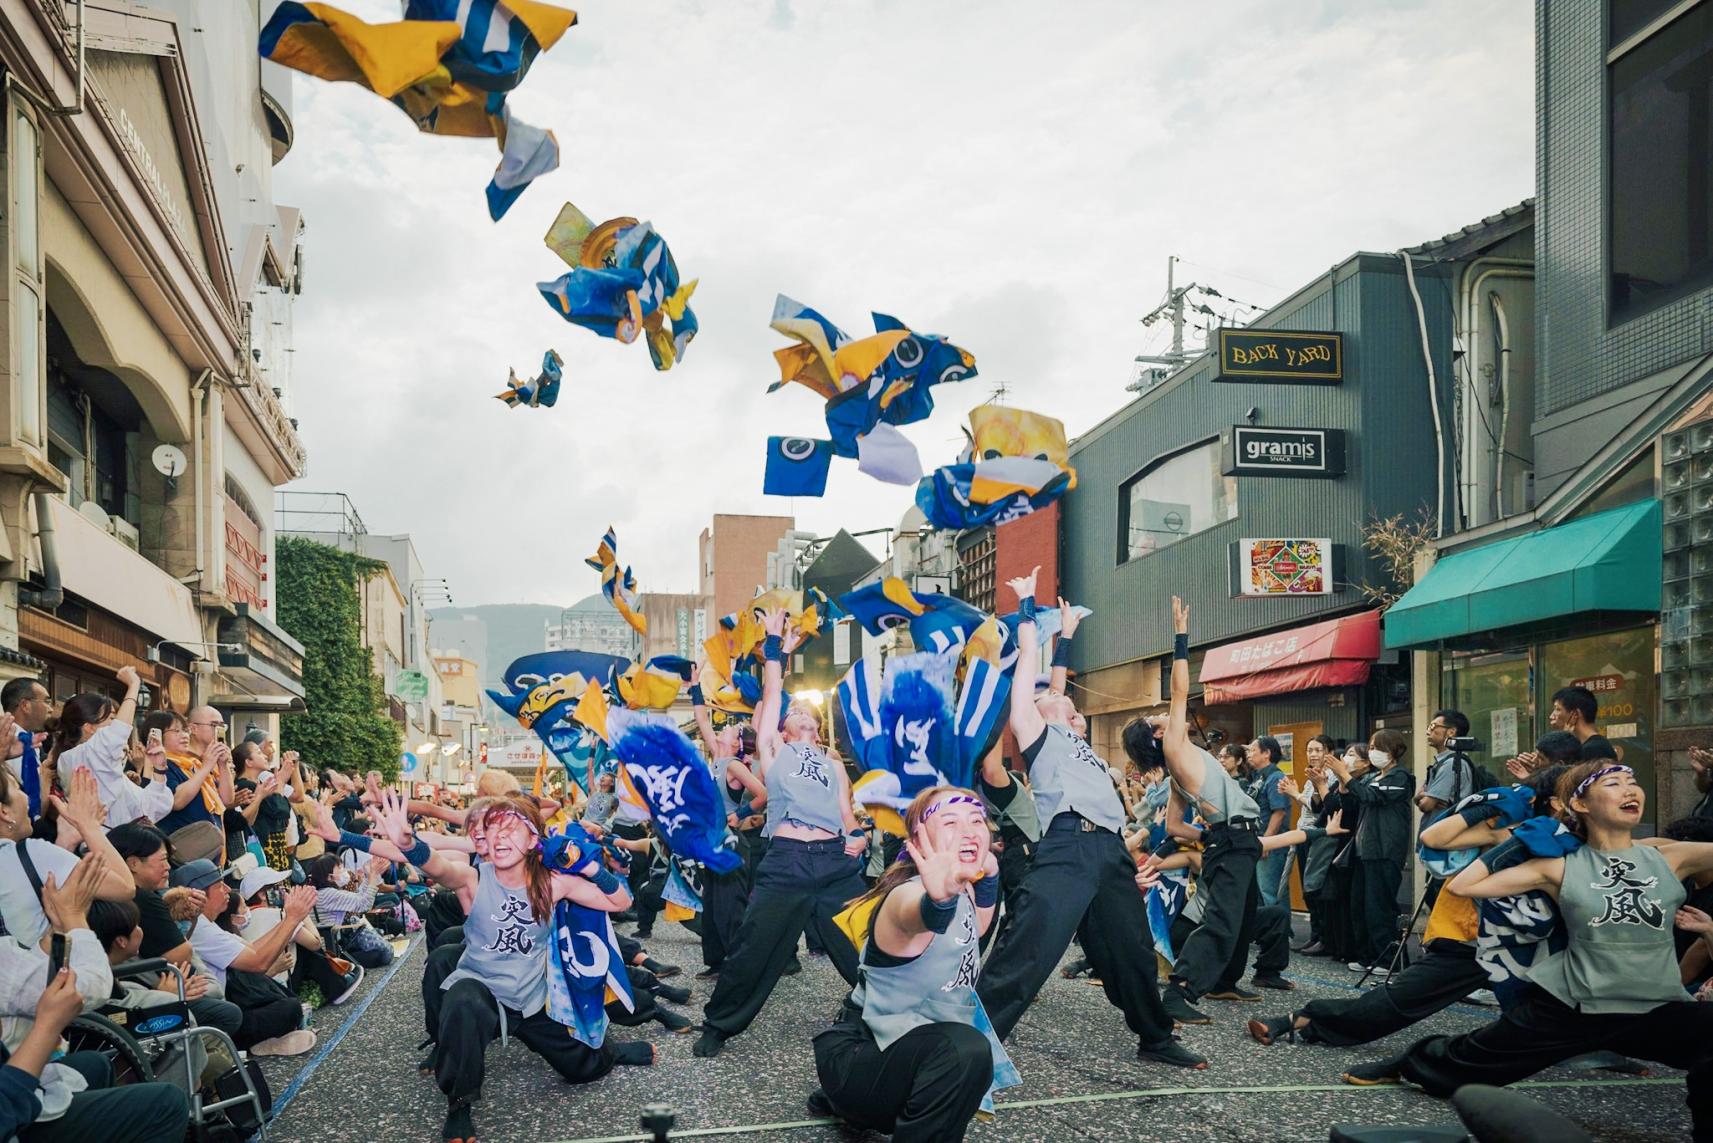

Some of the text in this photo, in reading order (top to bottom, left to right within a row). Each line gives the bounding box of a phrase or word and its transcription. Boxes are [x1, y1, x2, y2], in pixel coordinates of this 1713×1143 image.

[120, 107, 162, 194] CENTRAL
[1232, 344, 1331, 366] BACK YARD
[484, 895, 538, 957] 突風
[1588, 857, 1667, 931] 突風
